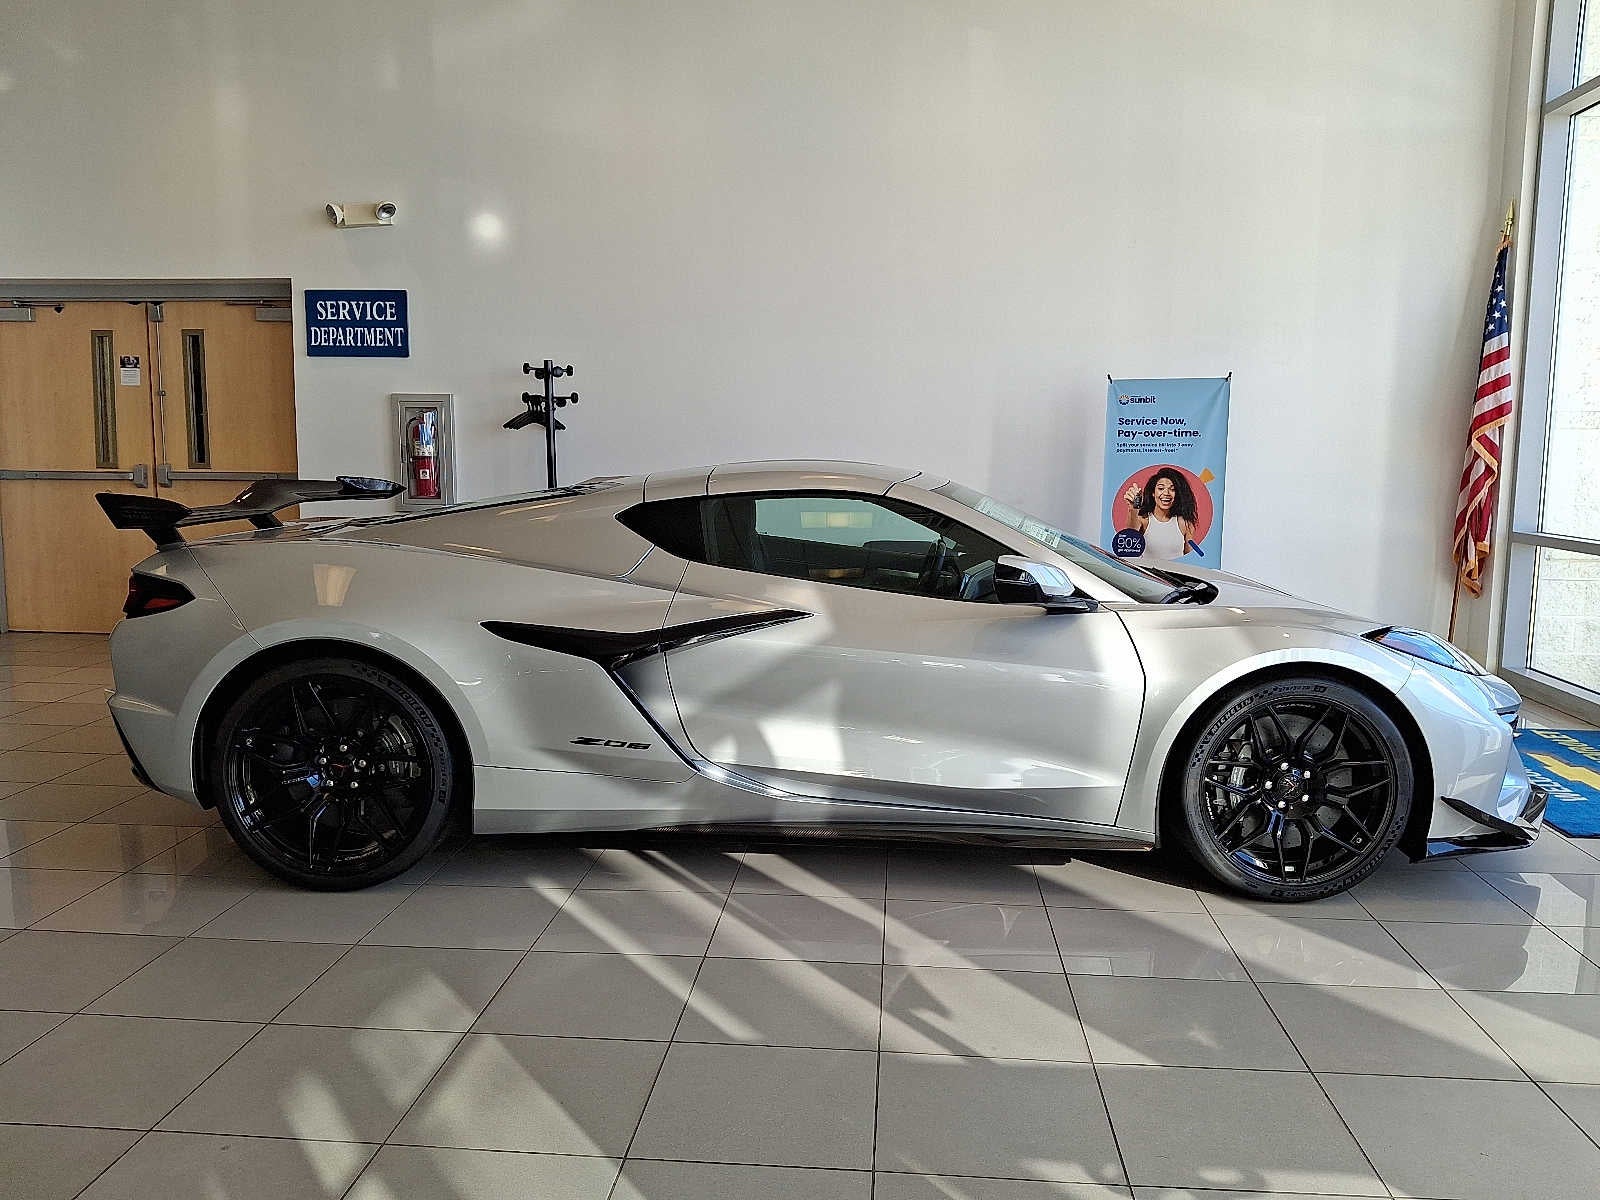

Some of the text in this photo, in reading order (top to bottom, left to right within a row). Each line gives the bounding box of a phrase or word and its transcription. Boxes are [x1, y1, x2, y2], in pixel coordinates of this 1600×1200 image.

[316, 301, 397, 320] SERVICE
[310, 327, 405, 346] DEPARTMENT
[1129, 395, 1156, 404] sunbit
[1118, 416, 1186, 426] Service Now,
[1117, 428, 1201, 440] Pay-over-time.
[1117, 537, 1142, 549] 90%
[569, 736, 652, 750] Z06
